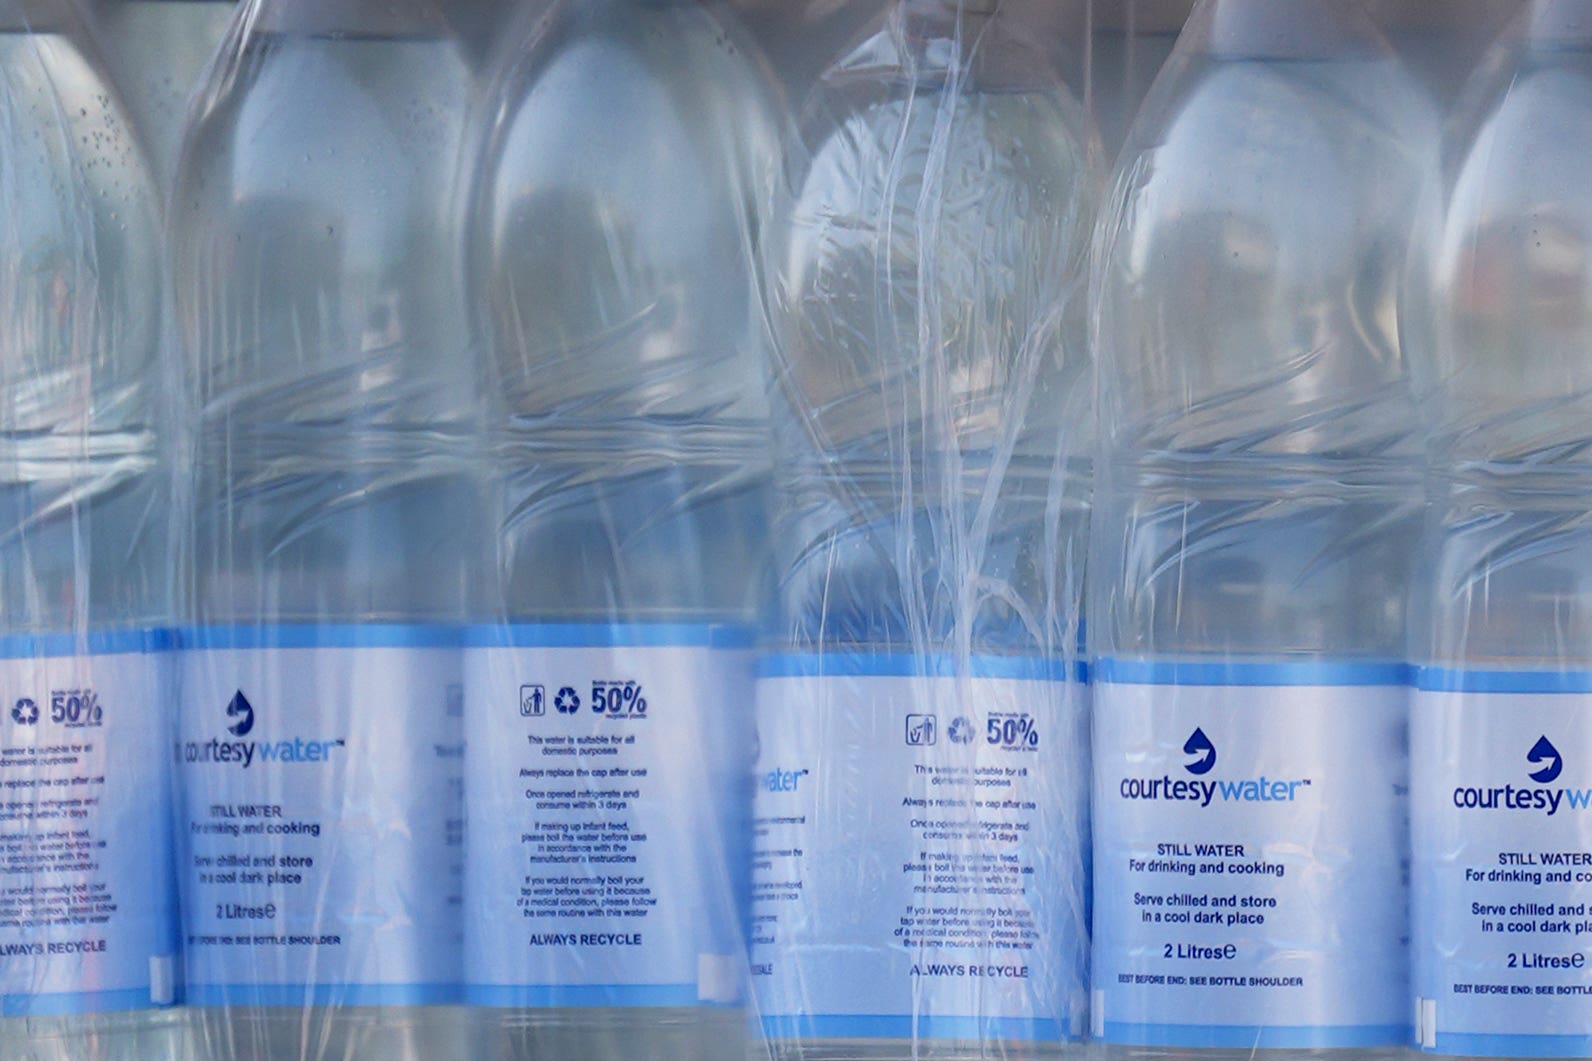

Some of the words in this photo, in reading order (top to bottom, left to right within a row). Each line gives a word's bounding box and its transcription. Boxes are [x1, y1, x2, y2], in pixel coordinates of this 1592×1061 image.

[591, 686, 648, 713] 50%
[51, 693, 103, 723] 50%
[987, 718, 1038, 747] 50%
[266, 822, 321, 837] cooking
[1158, 843, 1192, 857] STILL
[1195, 844, 1245, 857] WATER
[279, 856, 313, 868] store
[1499, 853, 1538, 866] STILL
[1540, 853, 1592, 866] WATER
[1129, 859, 1146, 872] For
[1148, 860, 1196, 876] drinking
[1199, 862, 1225, 874] and
[1228, 862, 1285, 877] cooking
[268, 872, 302, 887] place
[1465, 869, 1486, 882] For
[1488, 869, 1542, 885] drinking
[1546, 870, 1572, 883] and
[1134, 893, 1164, 906] Serve
[1166, 894, 1208, 907] chilled
[1211, 895, 1237, 908] and
[1241, 896, 1277, 908] store
[1472, 902, 1507, 916] Serve
[1510, 903, 1555, 916] chilled
[1559, 904, 1585, 916] and
[1154, 912, 1162, 923] a
[1164, 911, 1191, 923] cool
[1194, 911, 1224, 923] dark
[1227, 912, 1265, 927] place
[1497, 922, 1505, 932] a
[1508, 920, 1536, 933] cool
[1540, 920, 1572, 933] dark
[530, 934, 577, 946] ALWAYS
[580, 934, 642, 946] RECYCLE
[0, 943, 44, 956] LWAYS
[47, 940, 107, 954] RECYCLE
[1163, 944, 1173, 958] 2
[1507, 953, 1518, 968] 2
[1190, 976, 1208, 986] SEE
[1209, 977, 1247, 986] BOTTLE
[1249, 977, 1304, 987] SHOULDER
[1454, 984, 1473, 994] BEST
[1474, 984, 1509, 995] BEFORE
[1535, 986, 1555, 996] SEE
